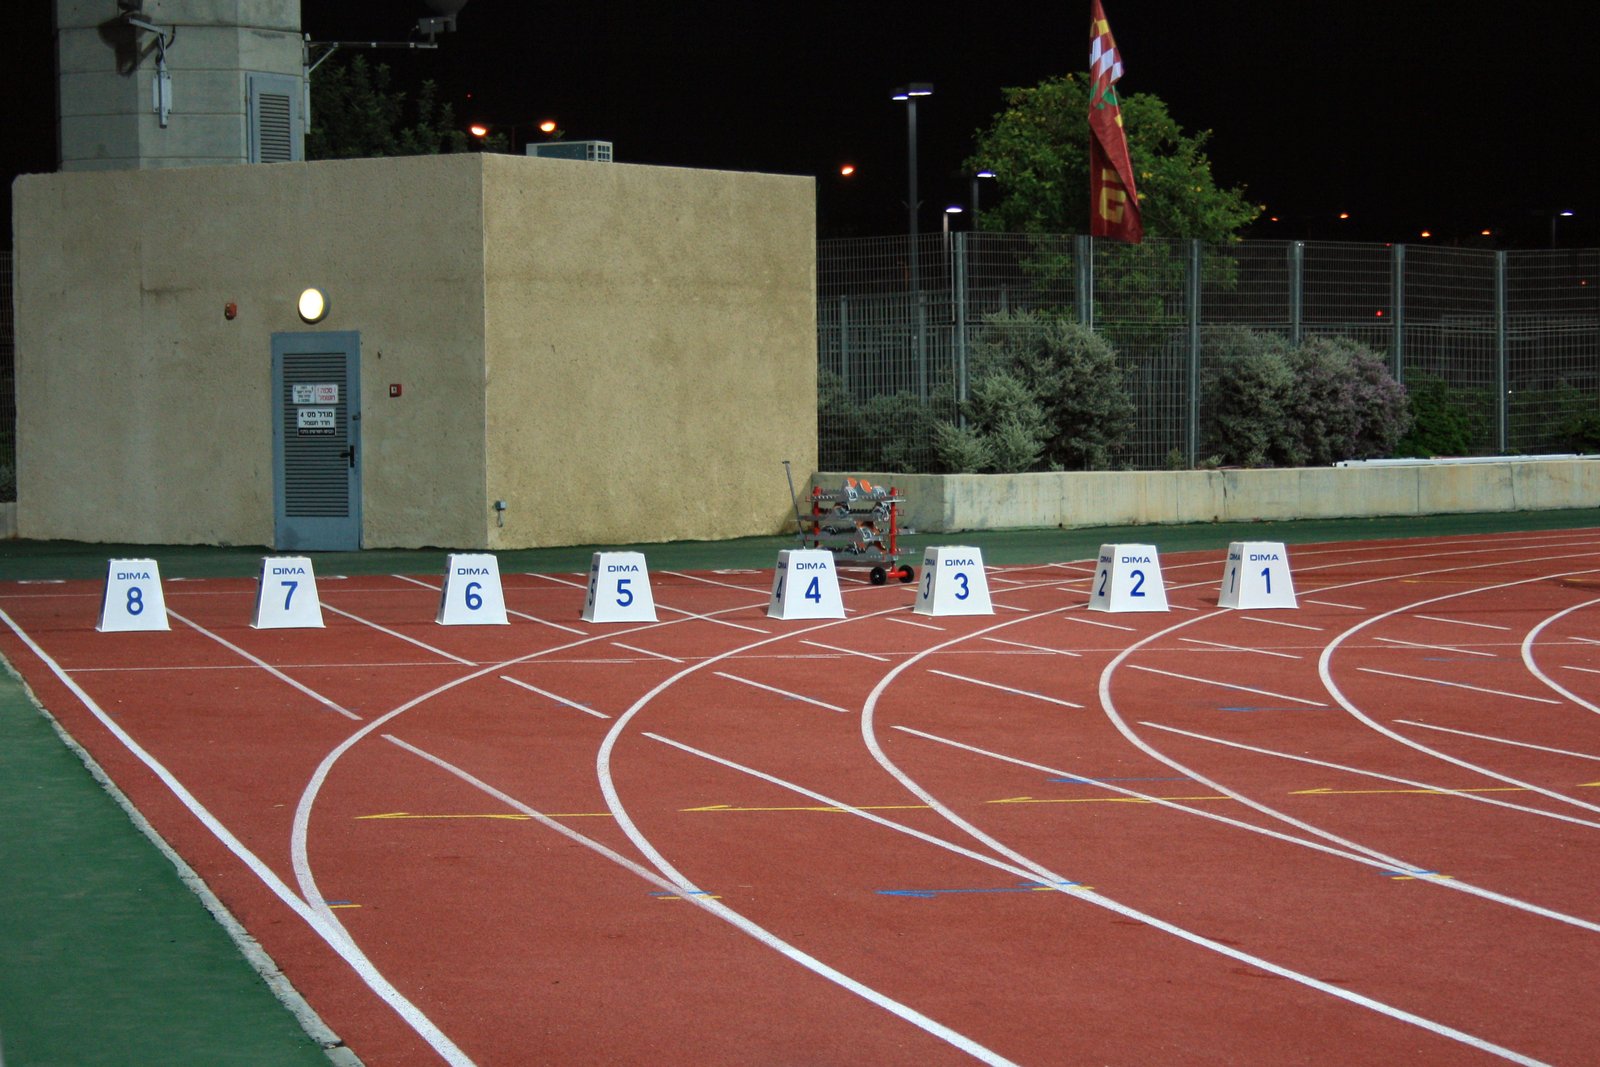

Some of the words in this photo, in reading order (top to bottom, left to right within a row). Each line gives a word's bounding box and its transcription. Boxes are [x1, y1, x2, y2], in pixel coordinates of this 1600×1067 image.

[272, 567, 306, 575] DIMA
[457, 567, 490, 576] DIMA
[607, 564, 639, 573] DIMA
[796, 562, 827, 570] DIMA
[945, 559, 975, 567] DIMA
[1121, 556, 1151, 564] DIMA
[116, 571, 151, 580] DIMA
[775, 575, 783, 604] 4
[804, 575, 822, 604] 4
[923, 572, 931, 600] 3
[953, 572, 970, 600] 3
[1098, 569, 1107, 597] 2
[1129, 569, 1146, 597] 2
[1260, 567, 1271, 594] 1
[126, 586, 144, 616] 8
[280, 580, 298, 611] 7
[464, 581, 483, 611] 6
[615, 578, 634, 607] 5
